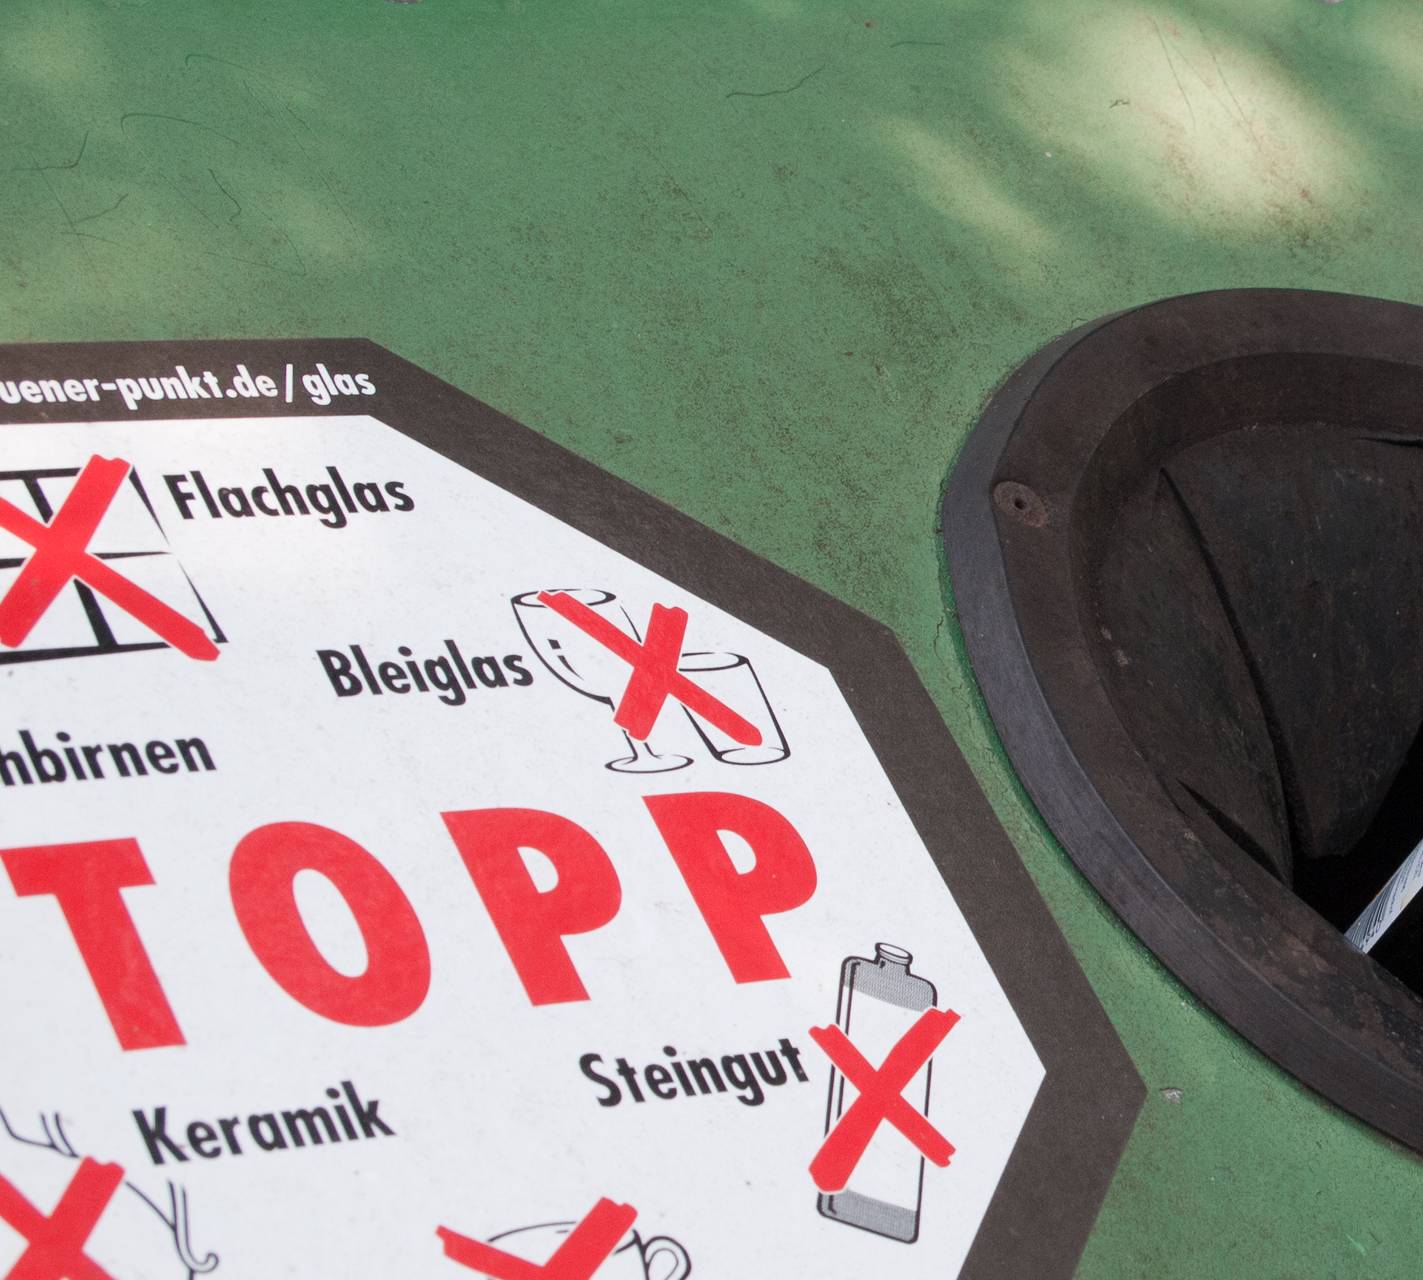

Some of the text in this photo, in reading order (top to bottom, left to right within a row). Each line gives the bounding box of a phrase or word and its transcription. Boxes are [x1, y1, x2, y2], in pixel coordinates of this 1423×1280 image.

[163, 466, 415, 529] Flachglas
[316, 639, 533, 706] Bleiglas
[578, 1038, 809, 1107] Steingut
[132, 1080, 395, 1165] Keramik
